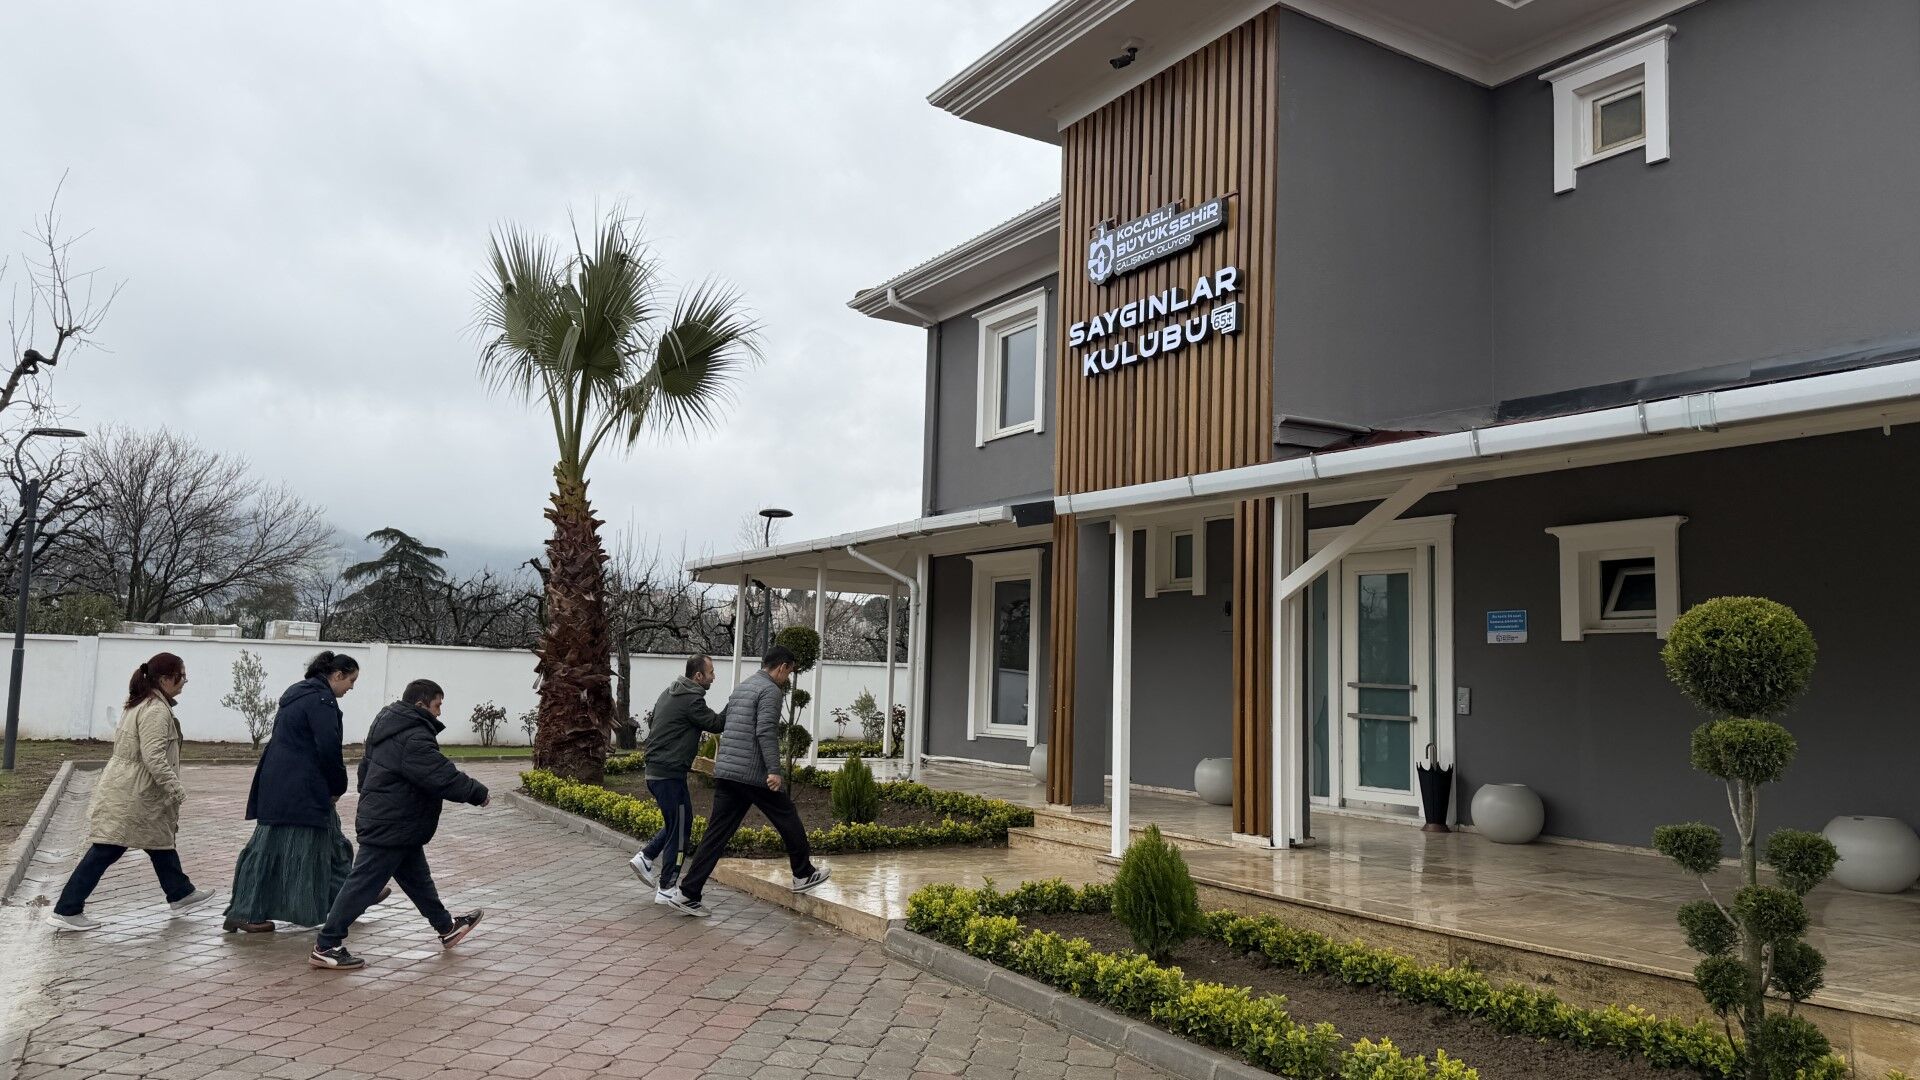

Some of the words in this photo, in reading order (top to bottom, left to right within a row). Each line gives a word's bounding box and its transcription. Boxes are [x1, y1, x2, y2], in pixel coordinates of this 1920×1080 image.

[1117, 208, 1172, 241] KOCAELİ
[1069, 266, 1237, 347] SAYGINLAR
[1083, 315, 1207, 376] KULÜBÜ
[1213, 314, 1233, 329] 65+
